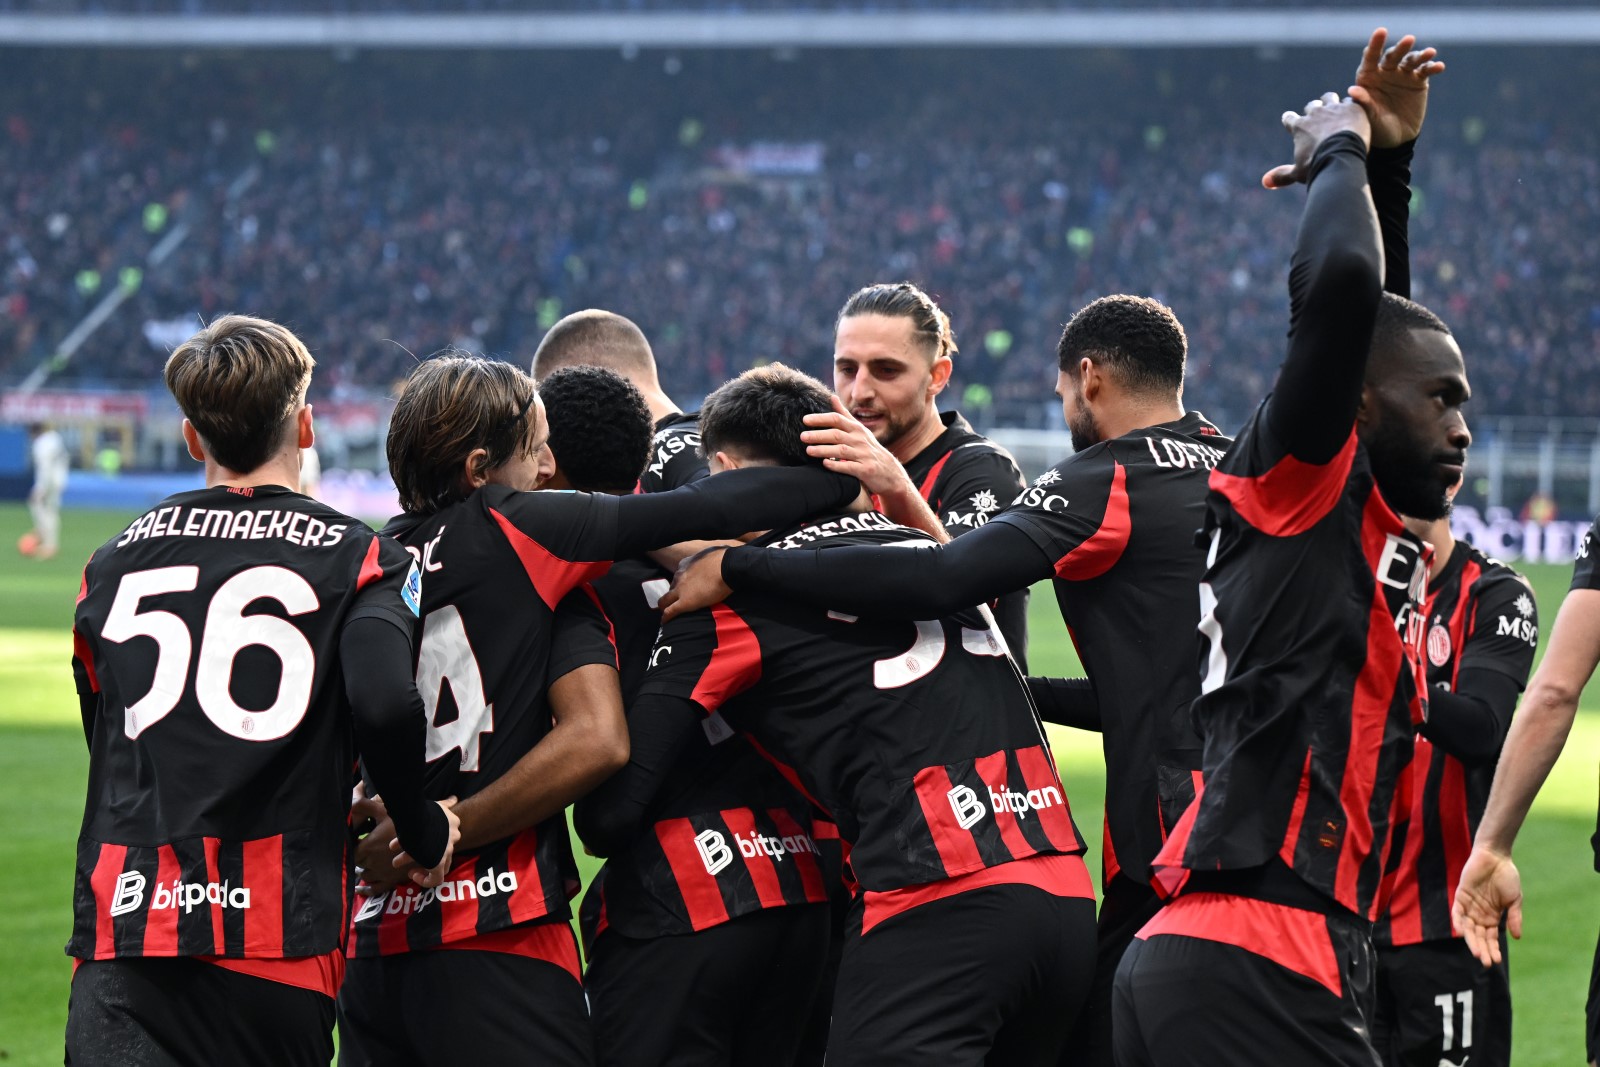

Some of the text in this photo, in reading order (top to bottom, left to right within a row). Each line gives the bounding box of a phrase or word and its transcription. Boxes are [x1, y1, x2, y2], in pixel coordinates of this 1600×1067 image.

[116, 506, 348, 549] SAELEMAEKERS
[1496, 615, 1538, 648] MSC
[101, 565, 320, 742] 56
[988, 784, 1064, 820] bitpan
[734, 831, 821, 862] bitpan
[386, 867, 518, 914] bitpanda
[1434, 989, 1473, 1051] 11
